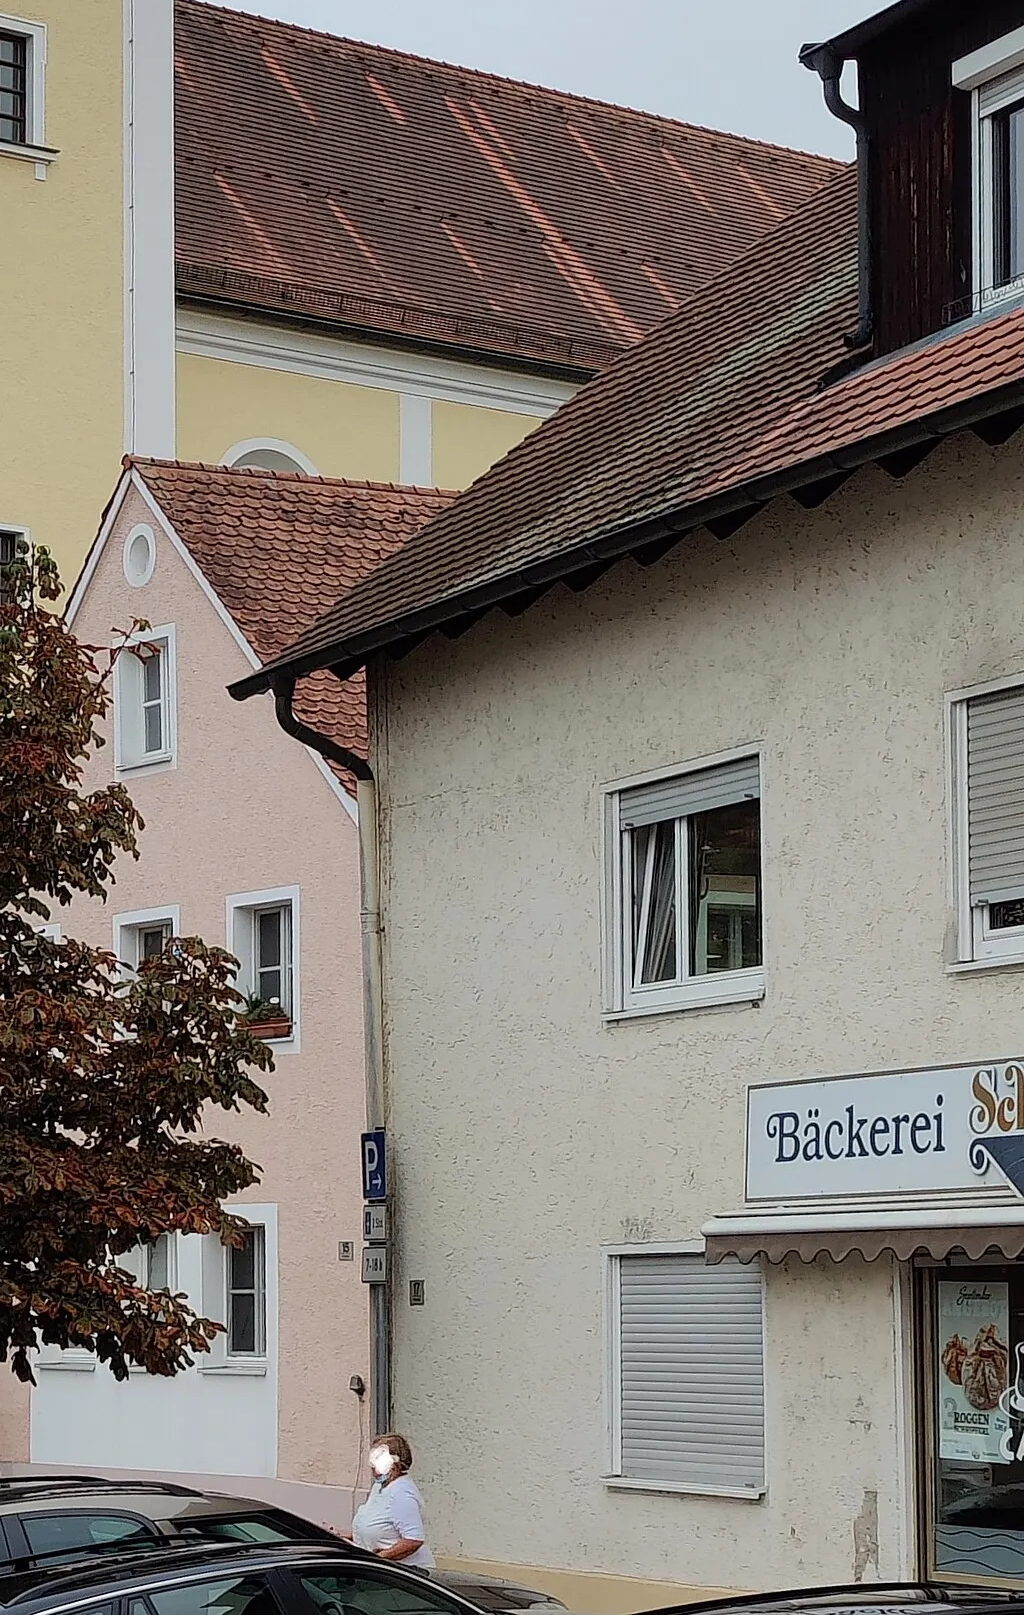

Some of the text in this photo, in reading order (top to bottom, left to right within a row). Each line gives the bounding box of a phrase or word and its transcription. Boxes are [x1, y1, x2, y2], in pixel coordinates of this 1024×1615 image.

[766, 1093, 946, 1163] Bäckerei
[365, 1141, 378, 1191] P
[954, 1412, 989, 1425] ROGGEN
